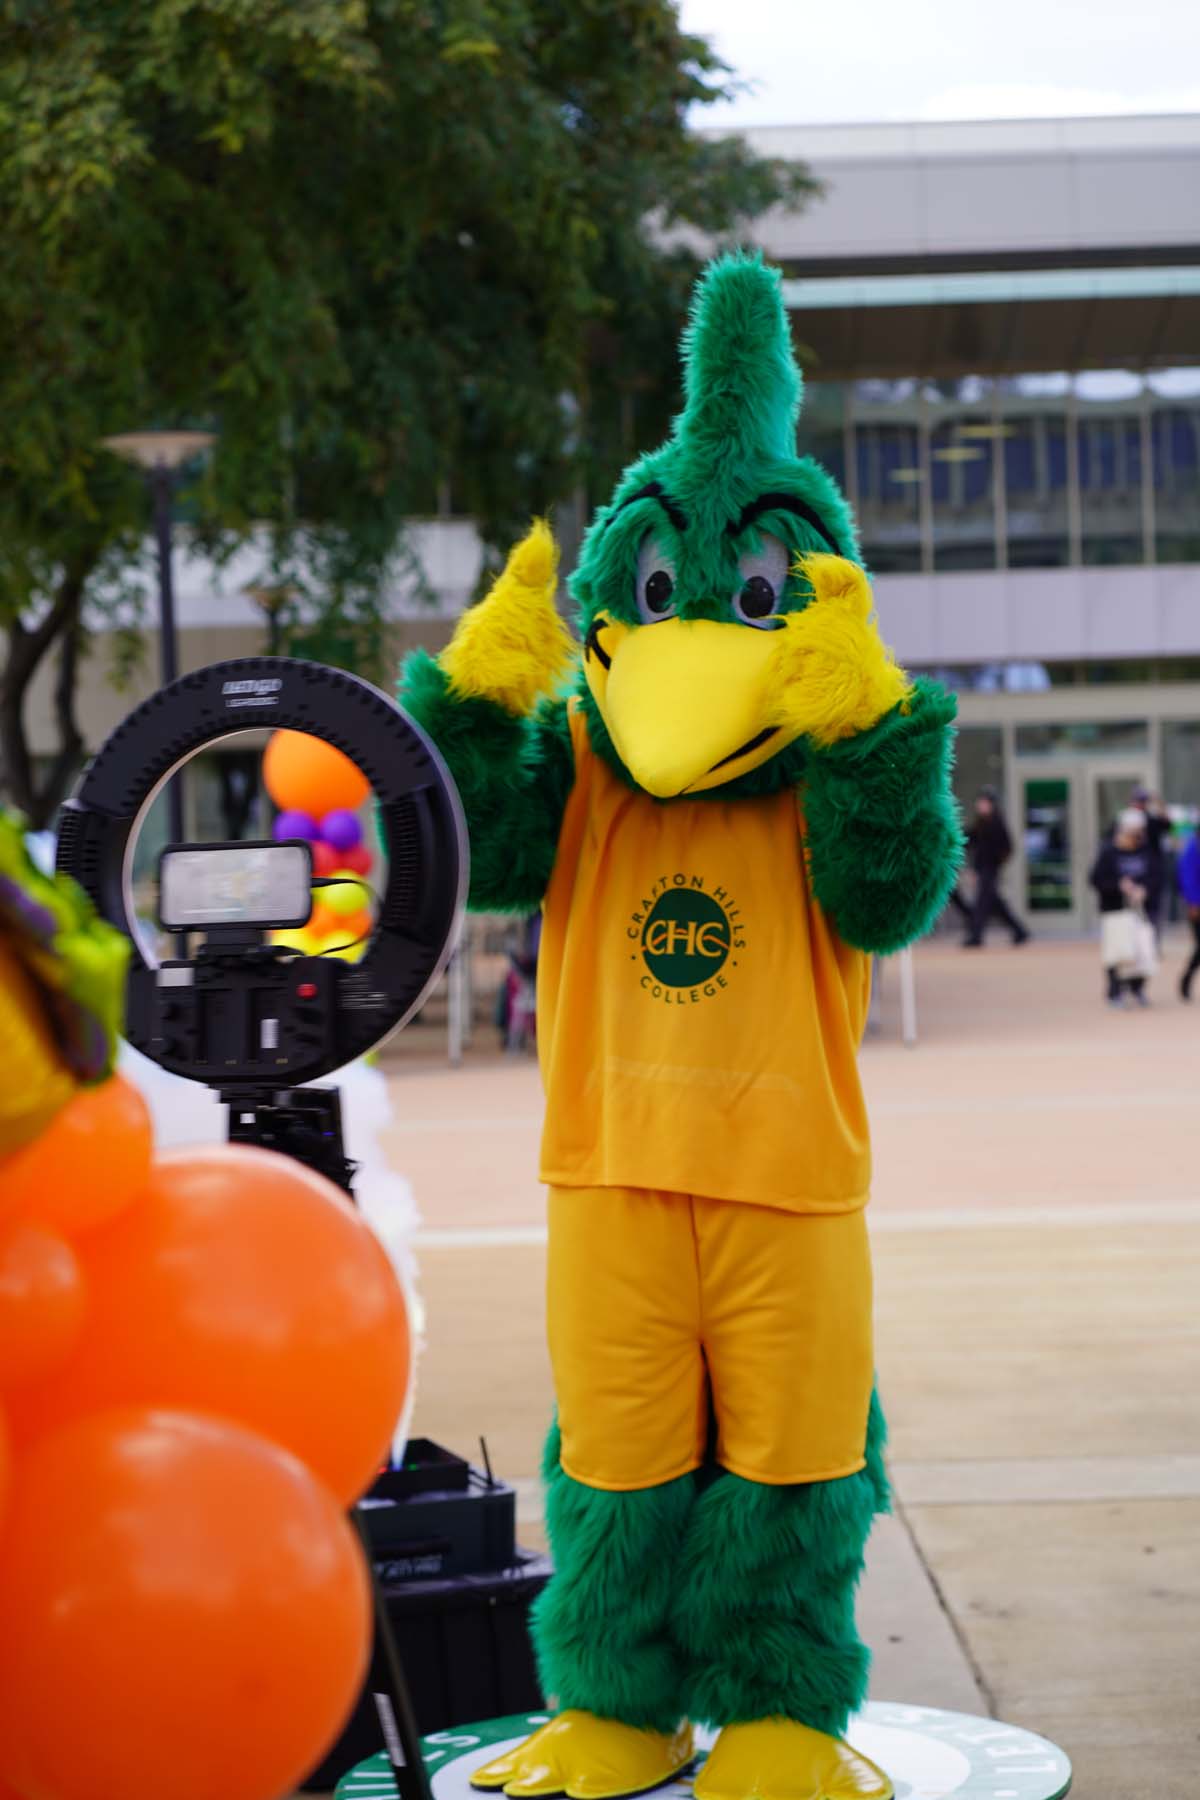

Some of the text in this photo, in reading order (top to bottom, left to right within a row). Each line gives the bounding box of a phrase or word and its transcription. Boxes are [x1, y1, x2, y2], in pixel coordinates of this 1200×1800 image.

[627, 873, 746, 948] CRAFTON HILLS
[645, 919, 724, 958] CHC
[640, 975, 728, 1004] COLLEGE
